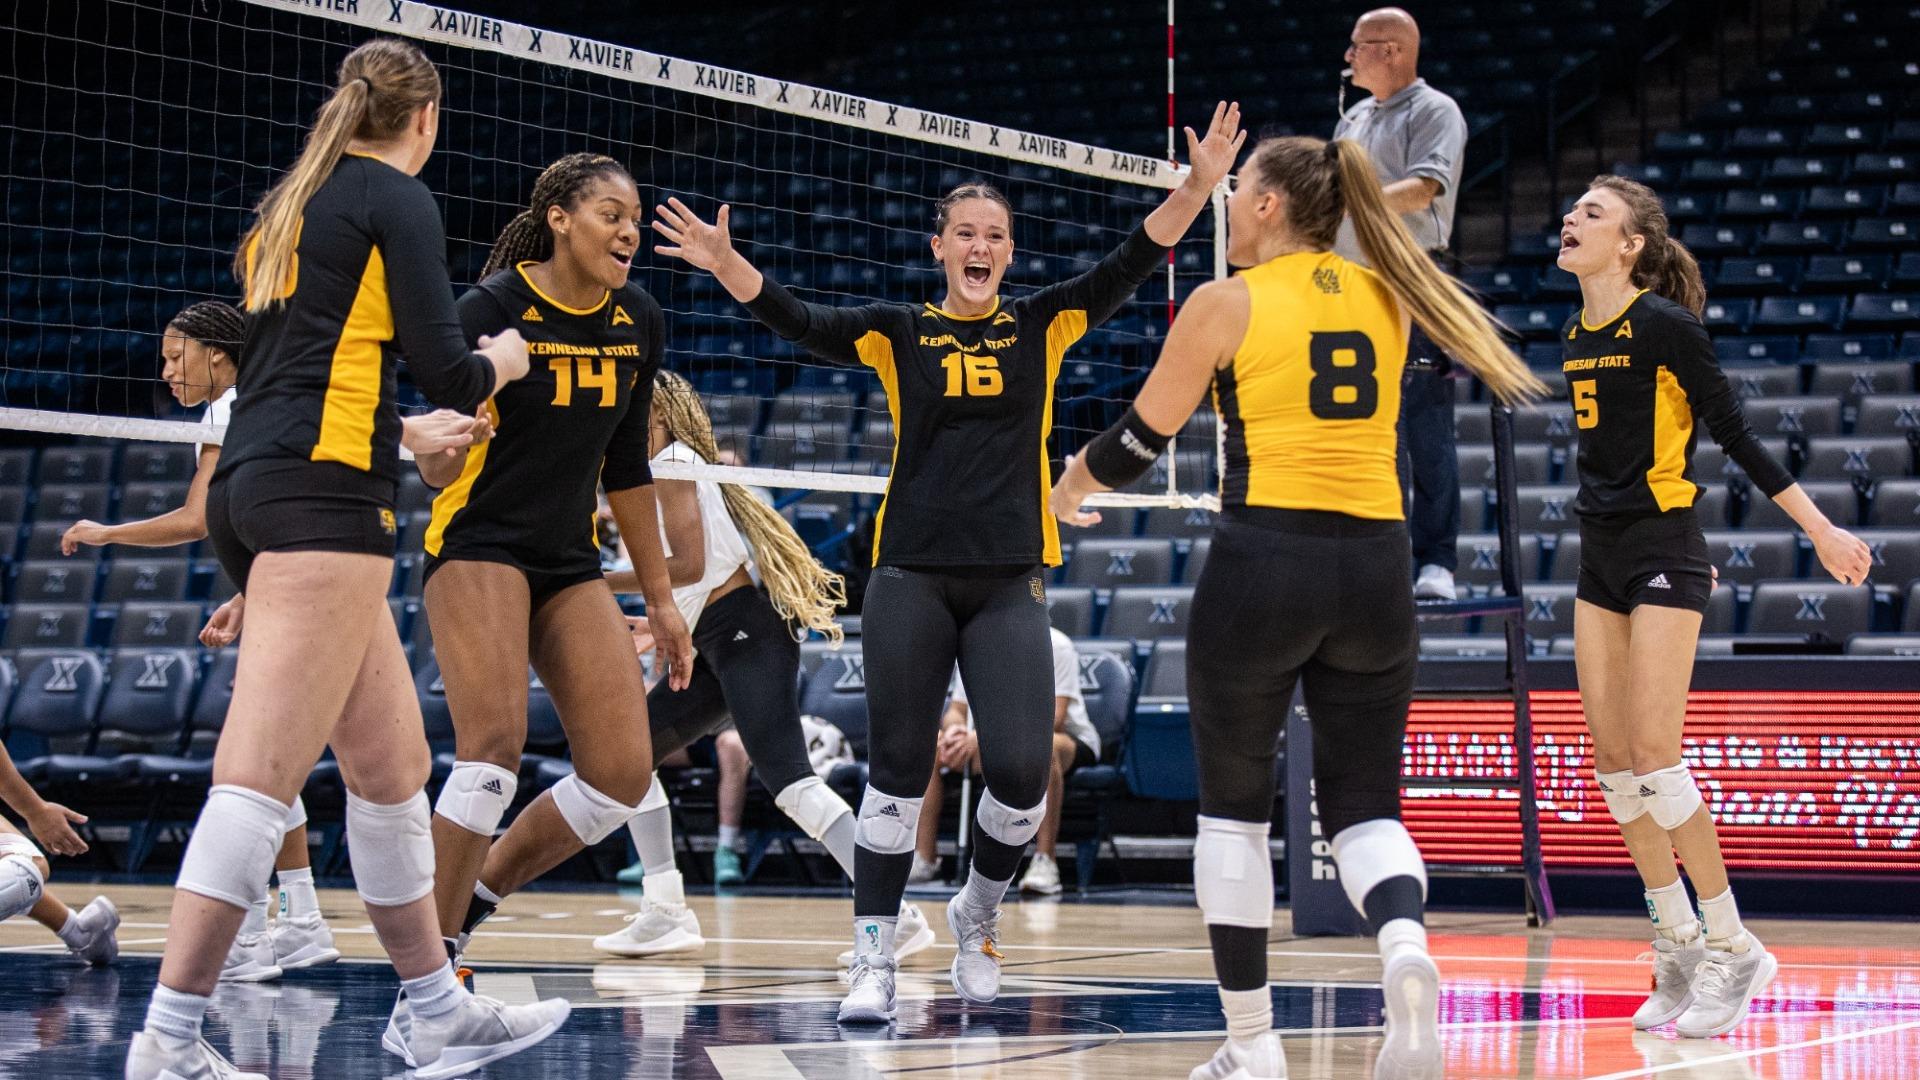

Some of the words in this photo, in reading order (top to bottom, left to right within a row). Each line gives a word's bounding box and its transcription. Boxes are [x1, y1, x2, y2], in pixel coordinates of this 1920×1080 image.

[388, 0, 402, 22] X
[430, 8, 503, 45] XAVIER
[529, 29, 543, 52] X
[569, 38, 634, 71] XAVIER
[658, 57, 671, 79] X
[694, 66, 757, 96] XAVIER
[776, 82, 789, 103] X
[810, 88, 867, 119] XAVIER
[886, 105, 898, 126] X
[918, 112, 972, 141] XAVIER
[988, 126, 1000, 147] X
[1017, 132, 1068, 160] XAVIER
[1084, 146, 1094, 165] X
[1110, 152, 1159, 178] XAVIER
[602, 344, 640, 356] STATE
[1597, 355, 1631, 368] STATE
[548, 356, 617, 407] 14
[940, 351, 1003, 397] 16
[1309, 330, 1379, 420] 8
[1572, 379, 1599, 430] 5
[1528, 594, 1557, 621] X
[1796, 593, 1826, 621] X
[44, 656, 85, 691] X
[135, 653, 178, 688] X
